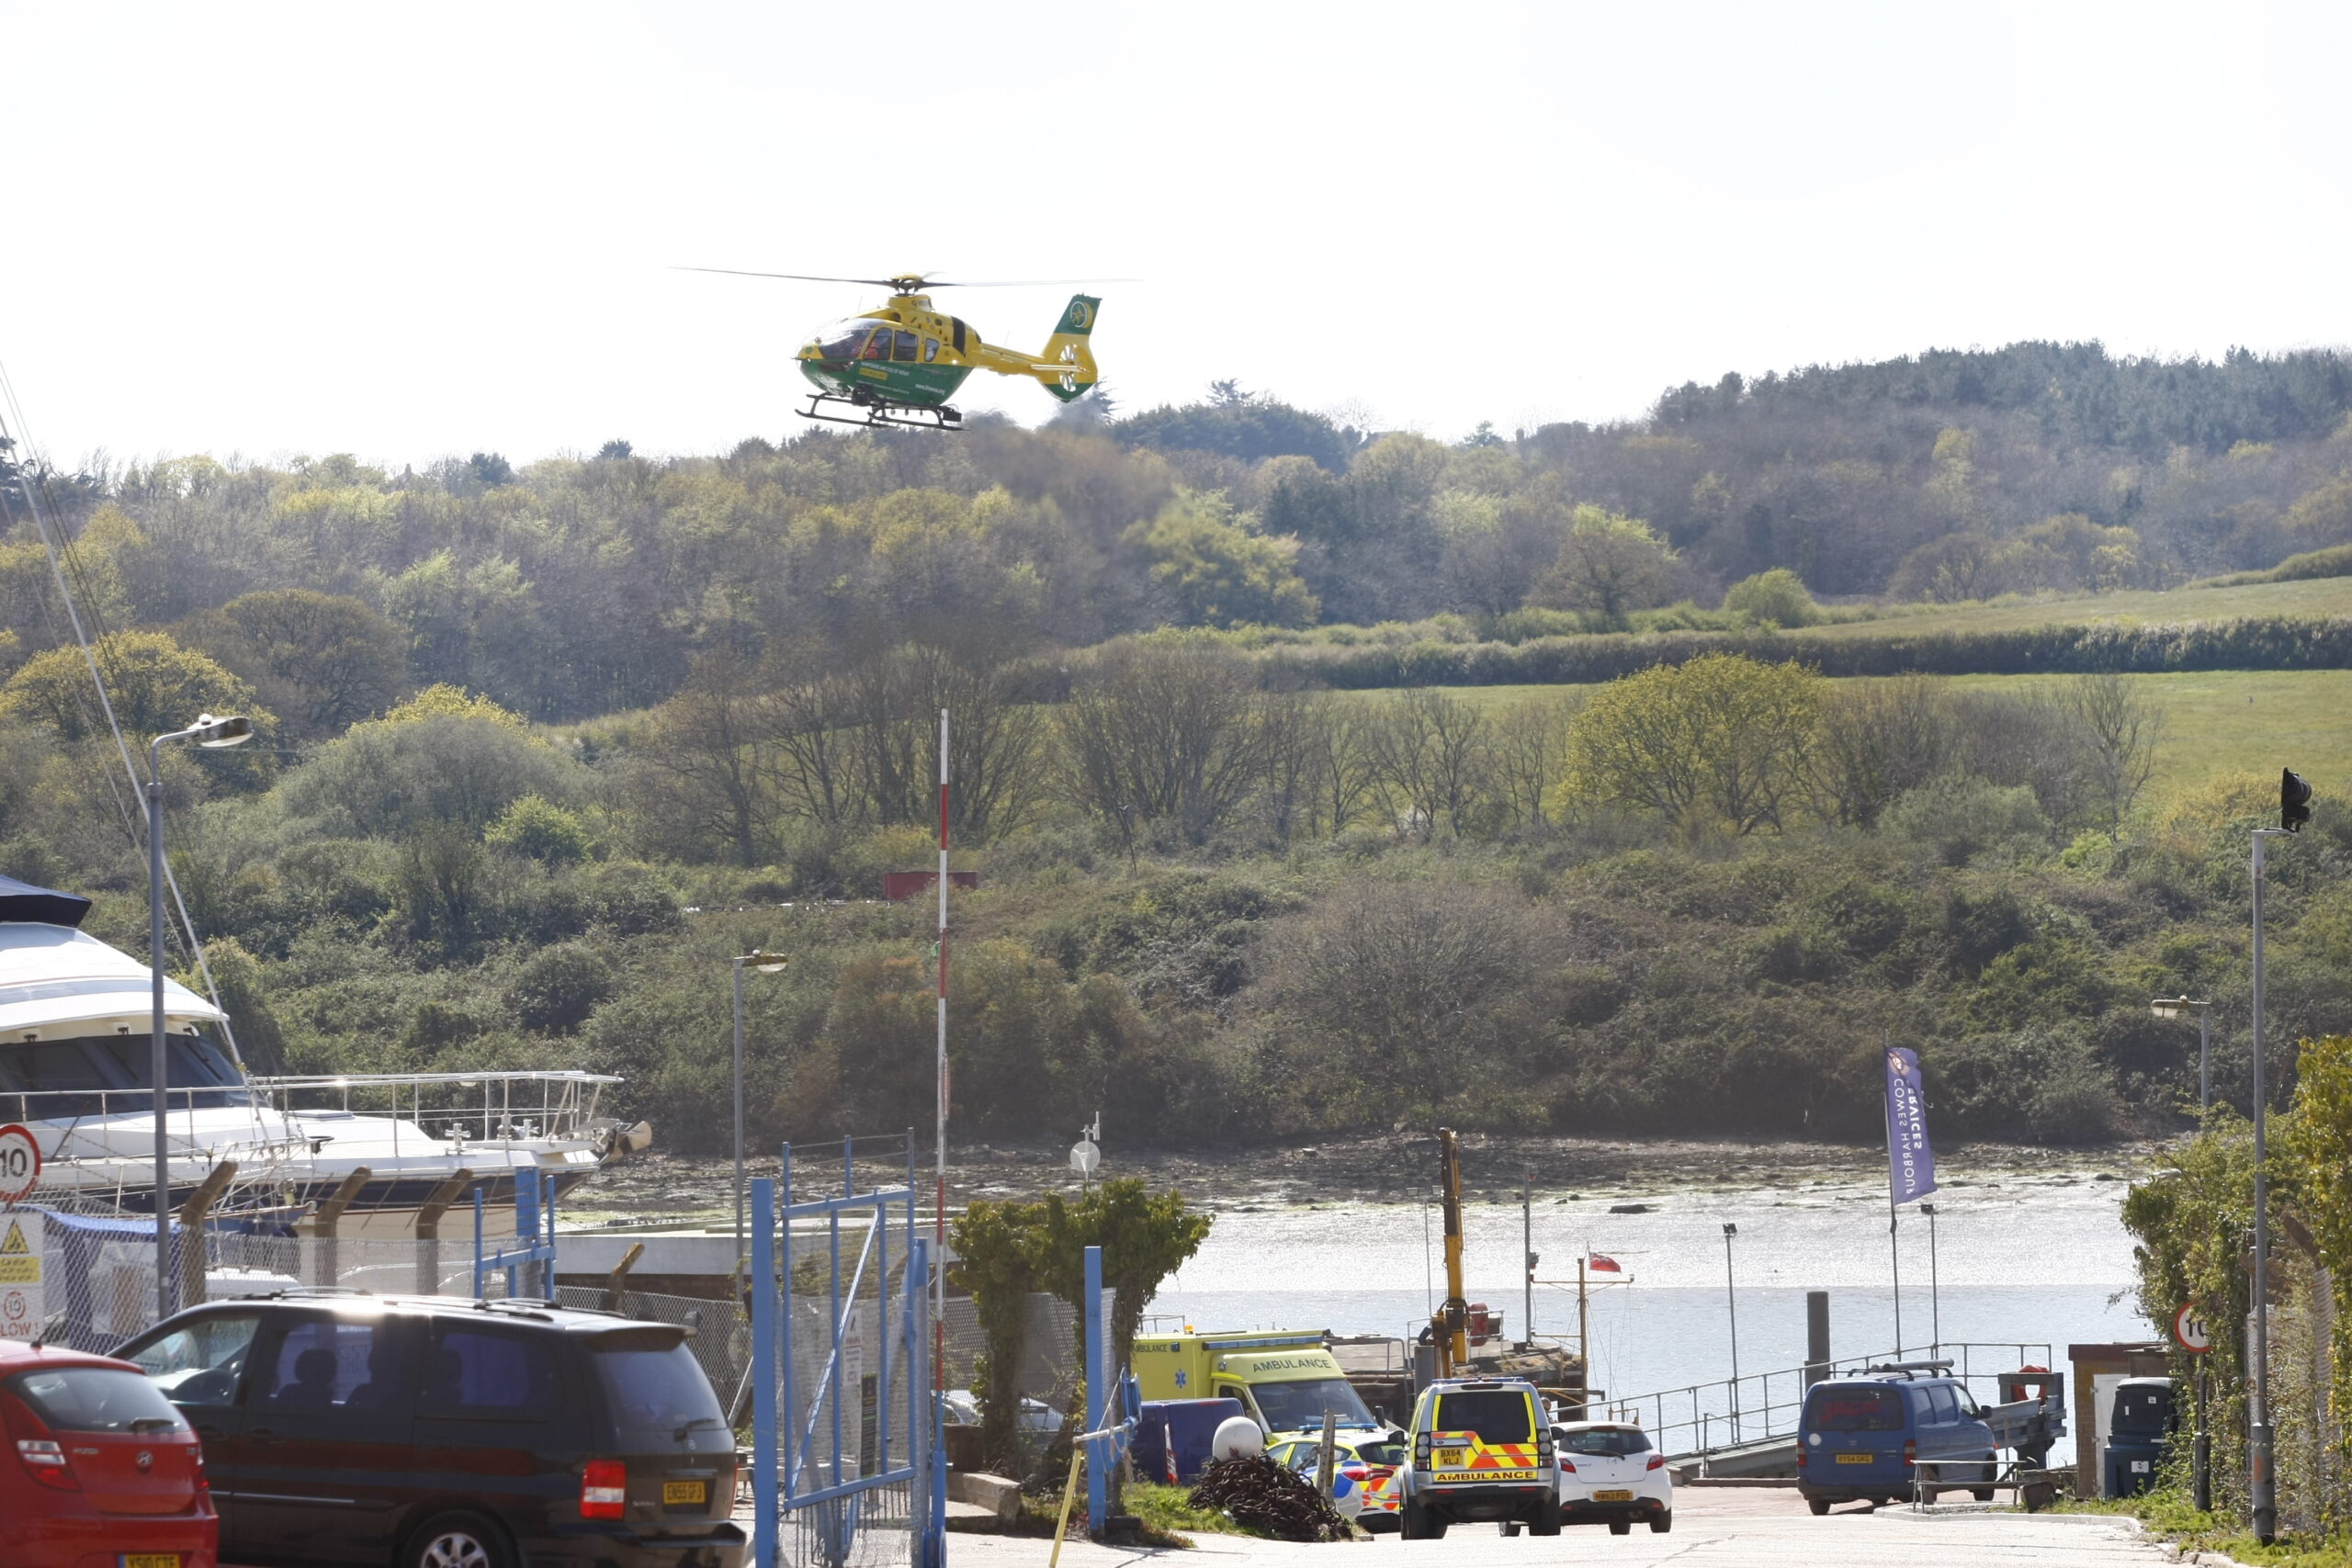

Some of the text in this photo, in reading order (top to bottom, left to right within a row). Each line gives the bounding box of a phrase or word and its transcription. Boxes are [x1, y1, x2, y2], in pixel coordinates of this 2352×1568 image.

[0, 1148, 27, 1178] 10
[1253, 1359, 1331, 1373] AMBULANCE
[1441, 1449, 1461, 1458] BX64
[1443, 1457, 1459, 1465] KLJ
[1437, 1472, 1534, 1481] AMBULANCE
